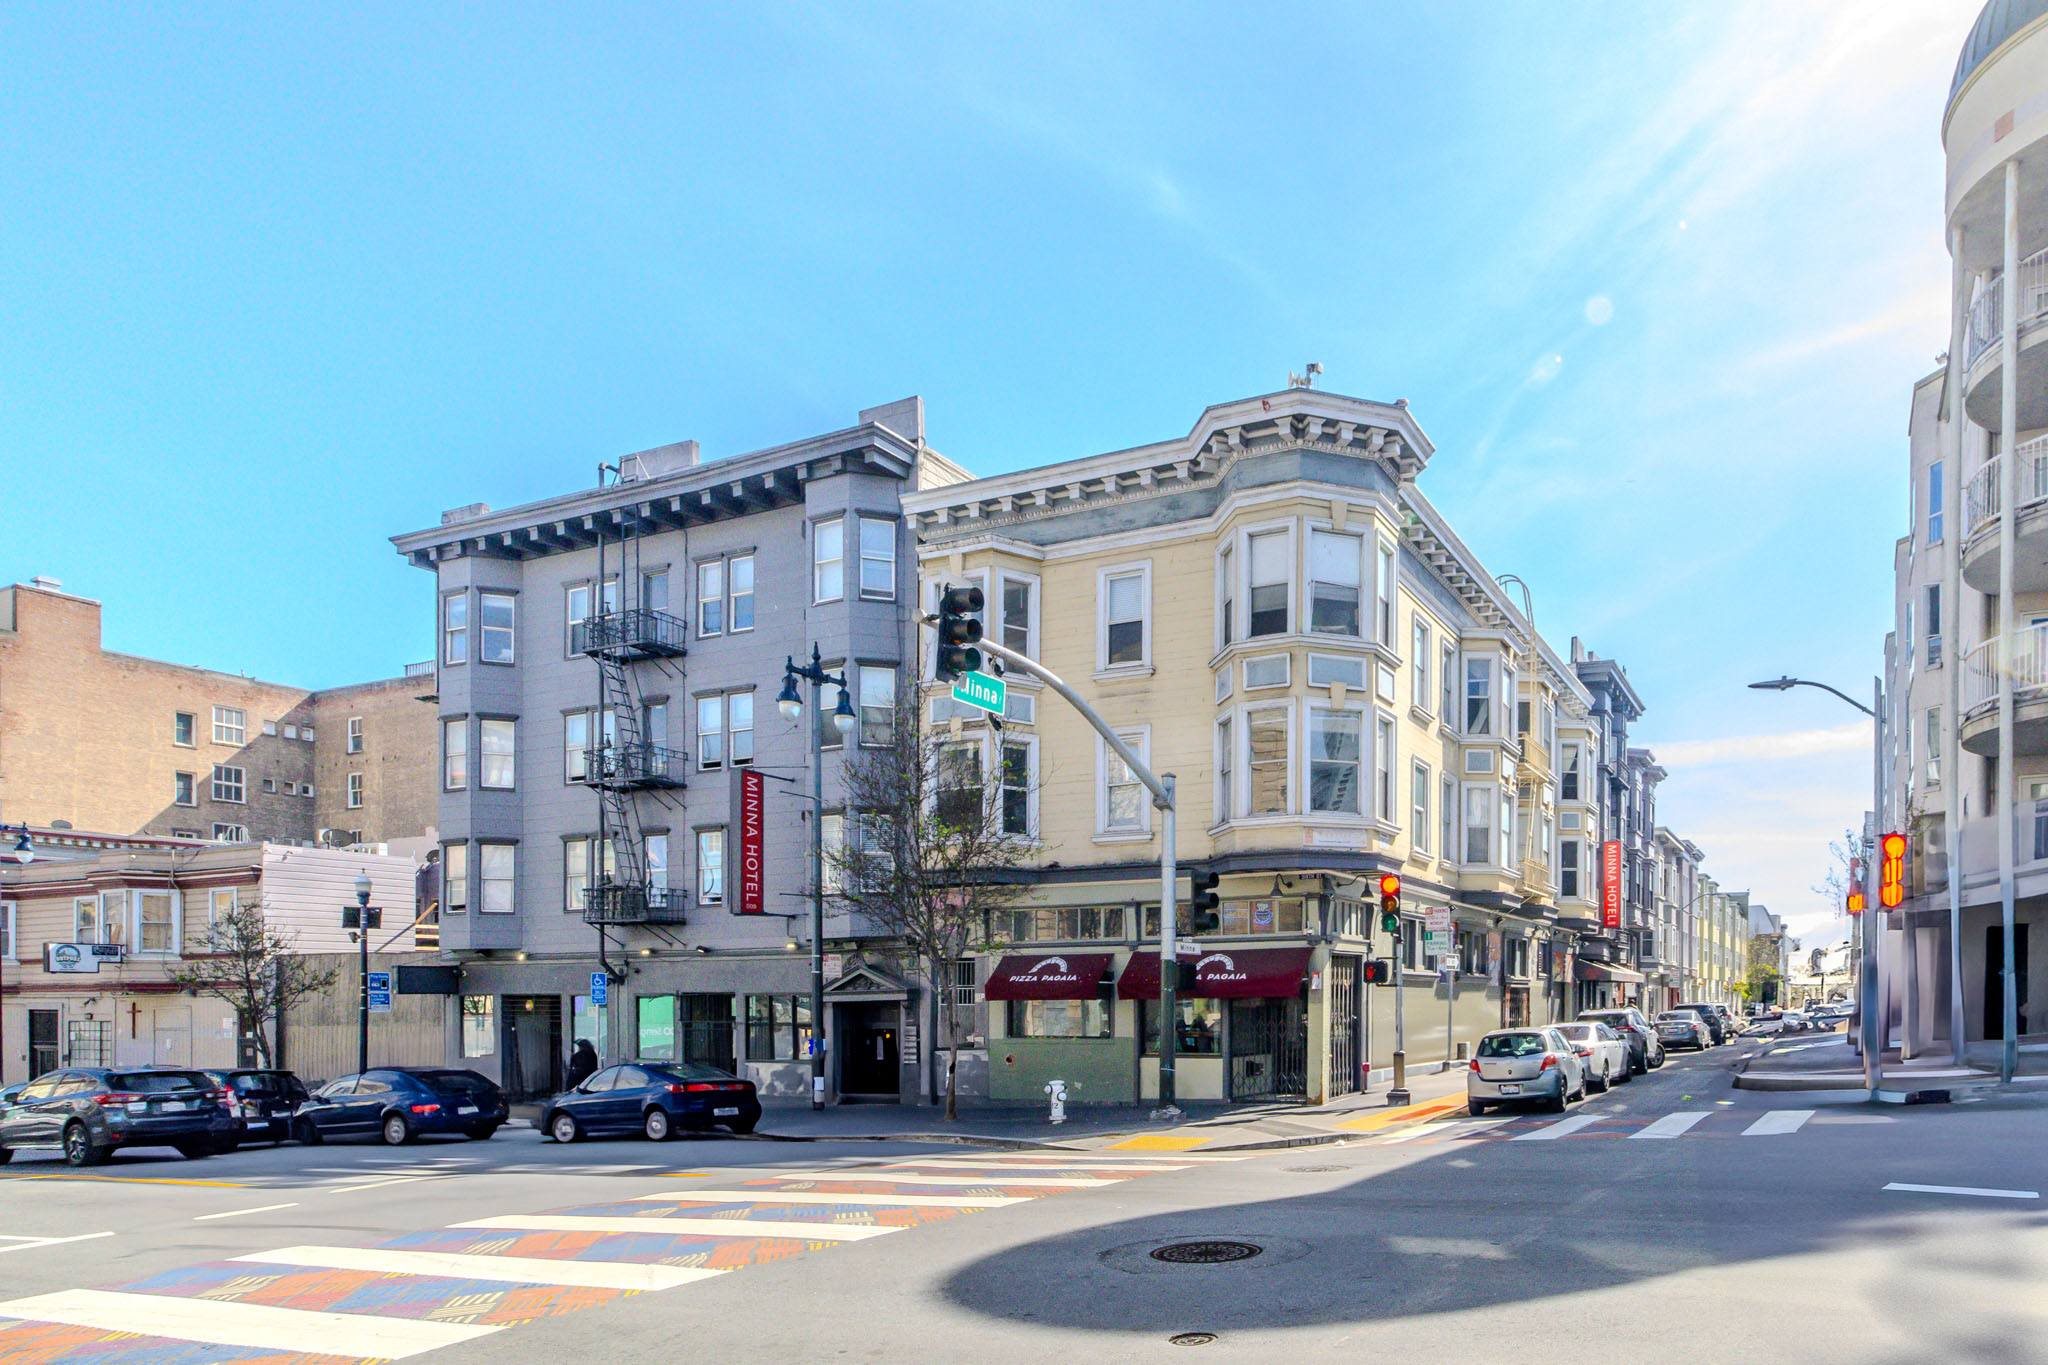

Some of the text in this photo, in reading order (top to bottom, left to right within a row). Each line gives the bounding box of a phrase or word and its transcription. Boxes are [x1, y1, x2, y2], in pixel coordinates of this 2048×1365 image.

[746, 776, 758, 901] MINNA HOTEL
[1607, 844, 1617, 882] MINNA
[1607, 885, 1617, 920] HOTEL
